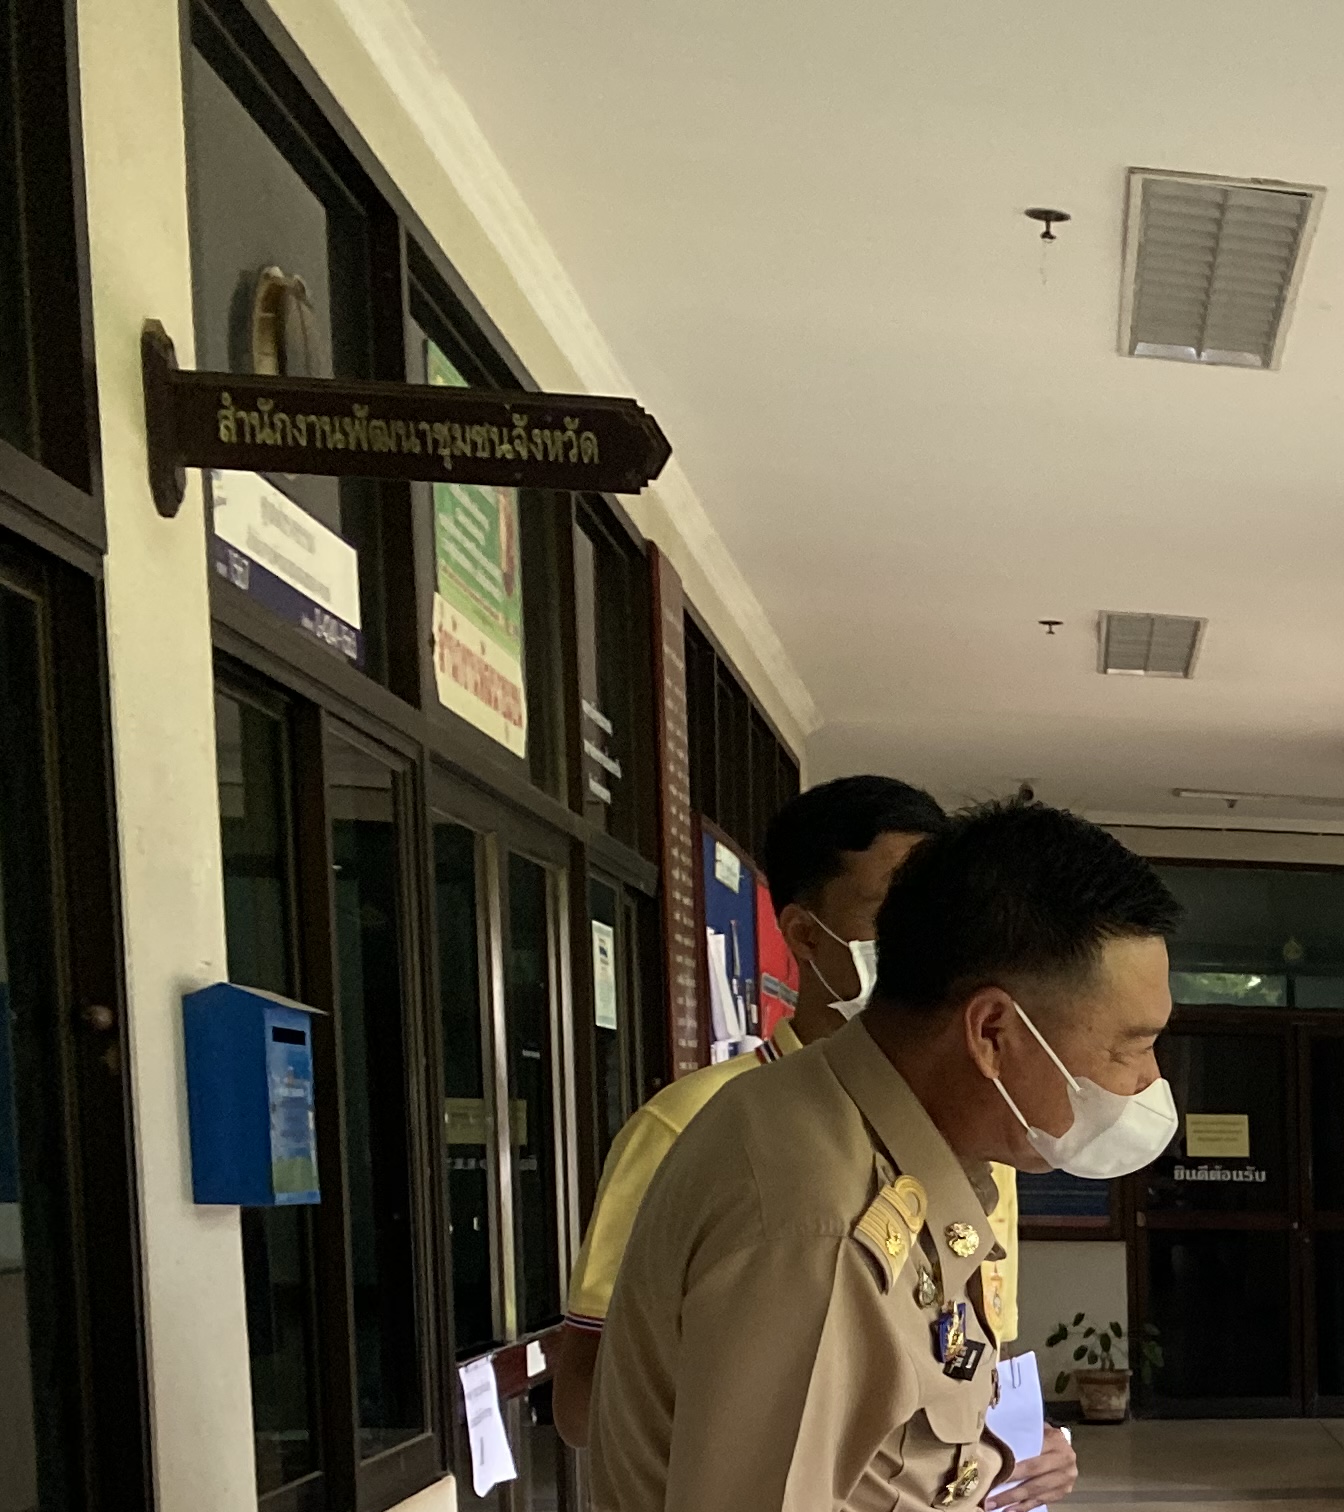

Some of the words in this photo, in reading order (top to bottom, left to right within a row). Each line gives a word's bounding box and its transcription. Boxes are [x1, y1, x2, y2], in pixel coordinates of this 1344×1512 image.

[217, 392, 599, 469] สำนักงานพัฒนาชุมชนจังหวัด
[1173, 1164, 1267, 1183] ยินดีต้อนรับ
